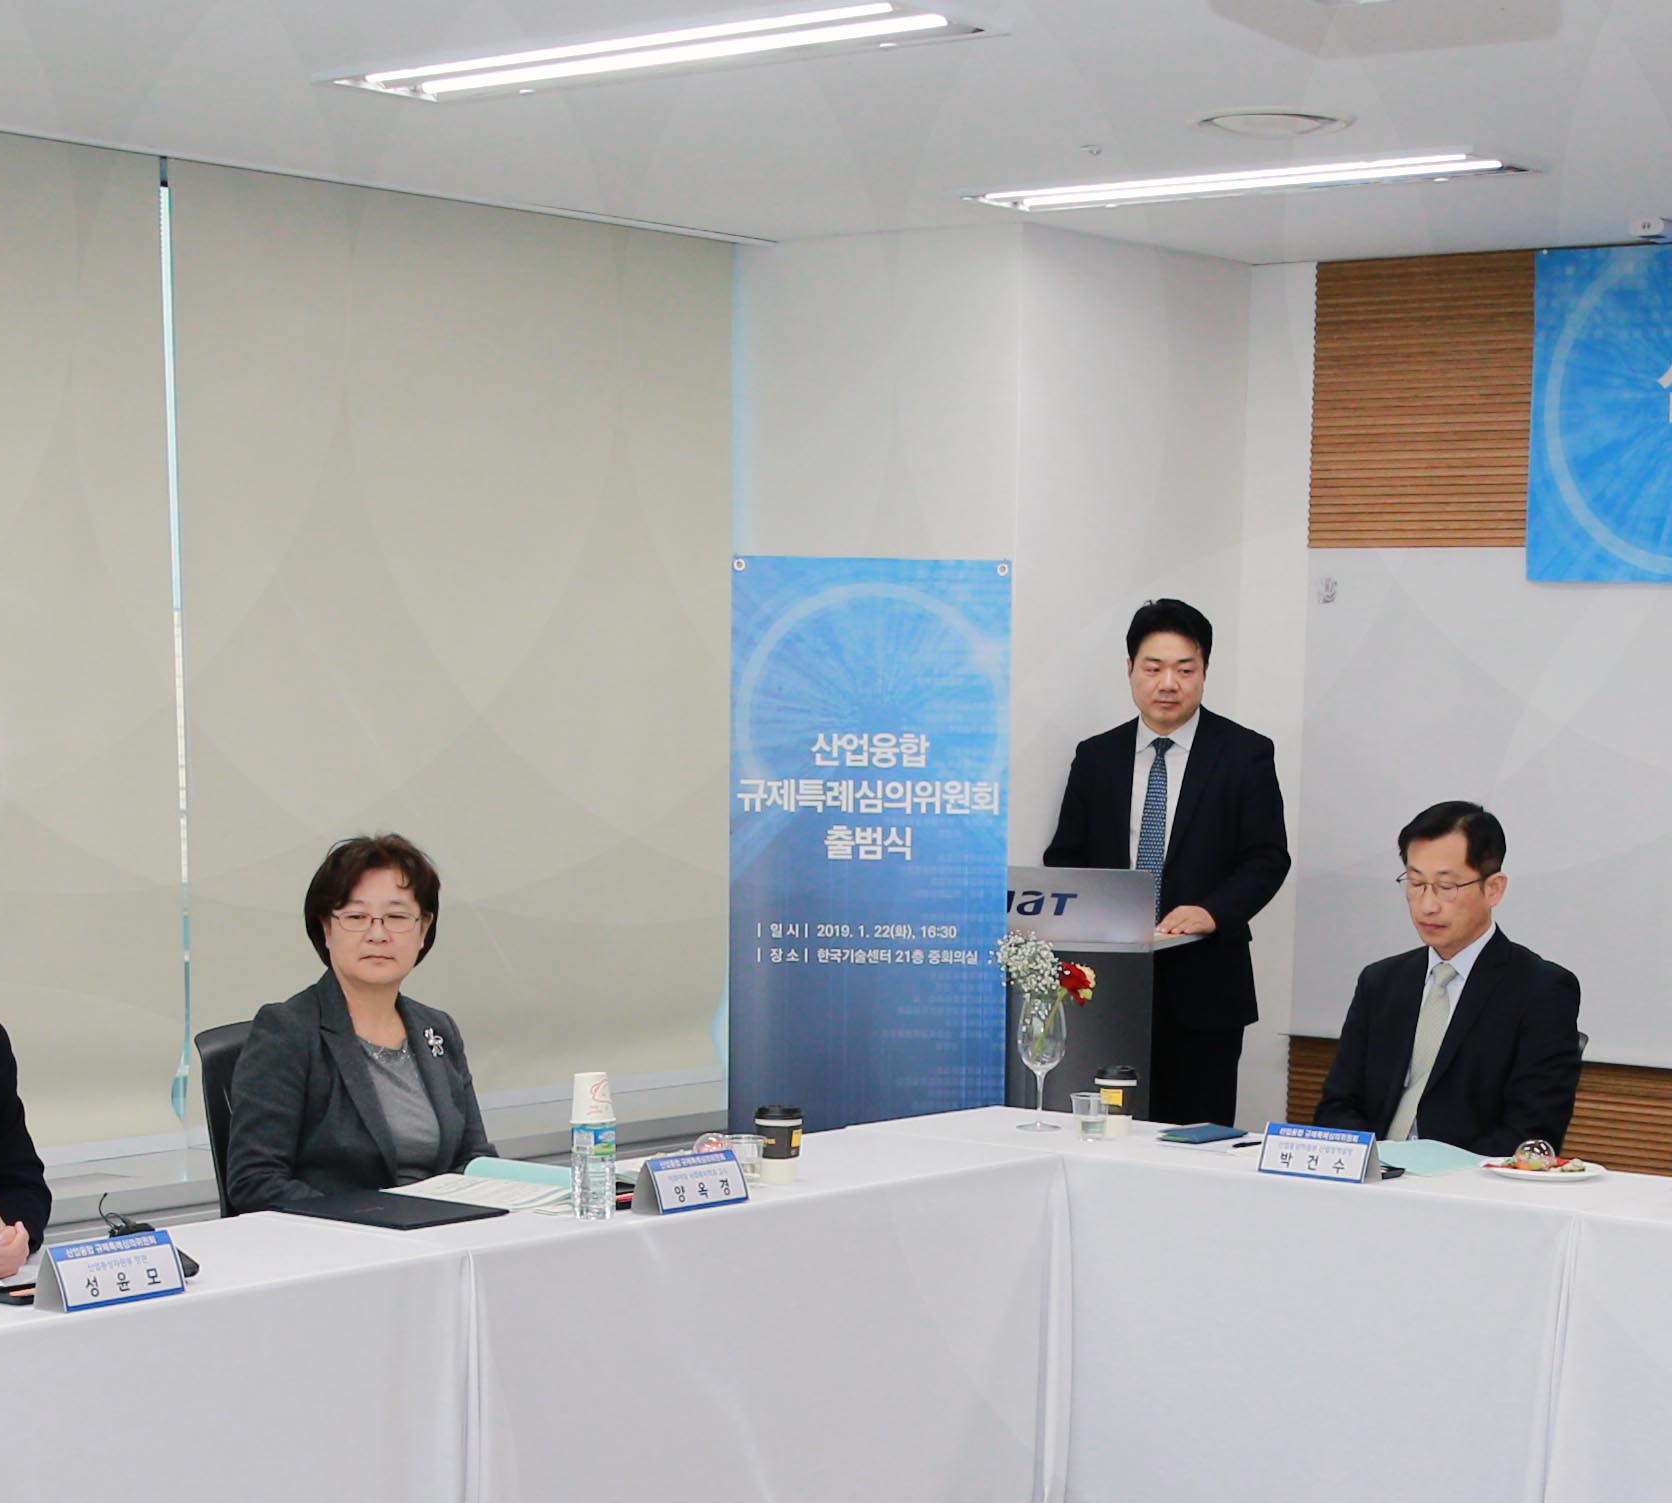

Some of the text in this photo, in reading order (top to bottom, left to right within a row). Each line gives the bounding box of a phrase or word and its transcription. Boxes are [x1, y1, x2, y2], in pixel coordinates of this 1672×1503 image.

[811, 732, 930, 768] 산업융합
[737, 778, 1000, 815] 규제특례심의위원회
[824, 824, 913, 861] 출범식
[921, 924, 957, 938] 16:30
[817, 949, 892, 964] 한국기술센터
[895, 950, 924, 965] 21층
[928, 949, 978, 966] 중회의실
